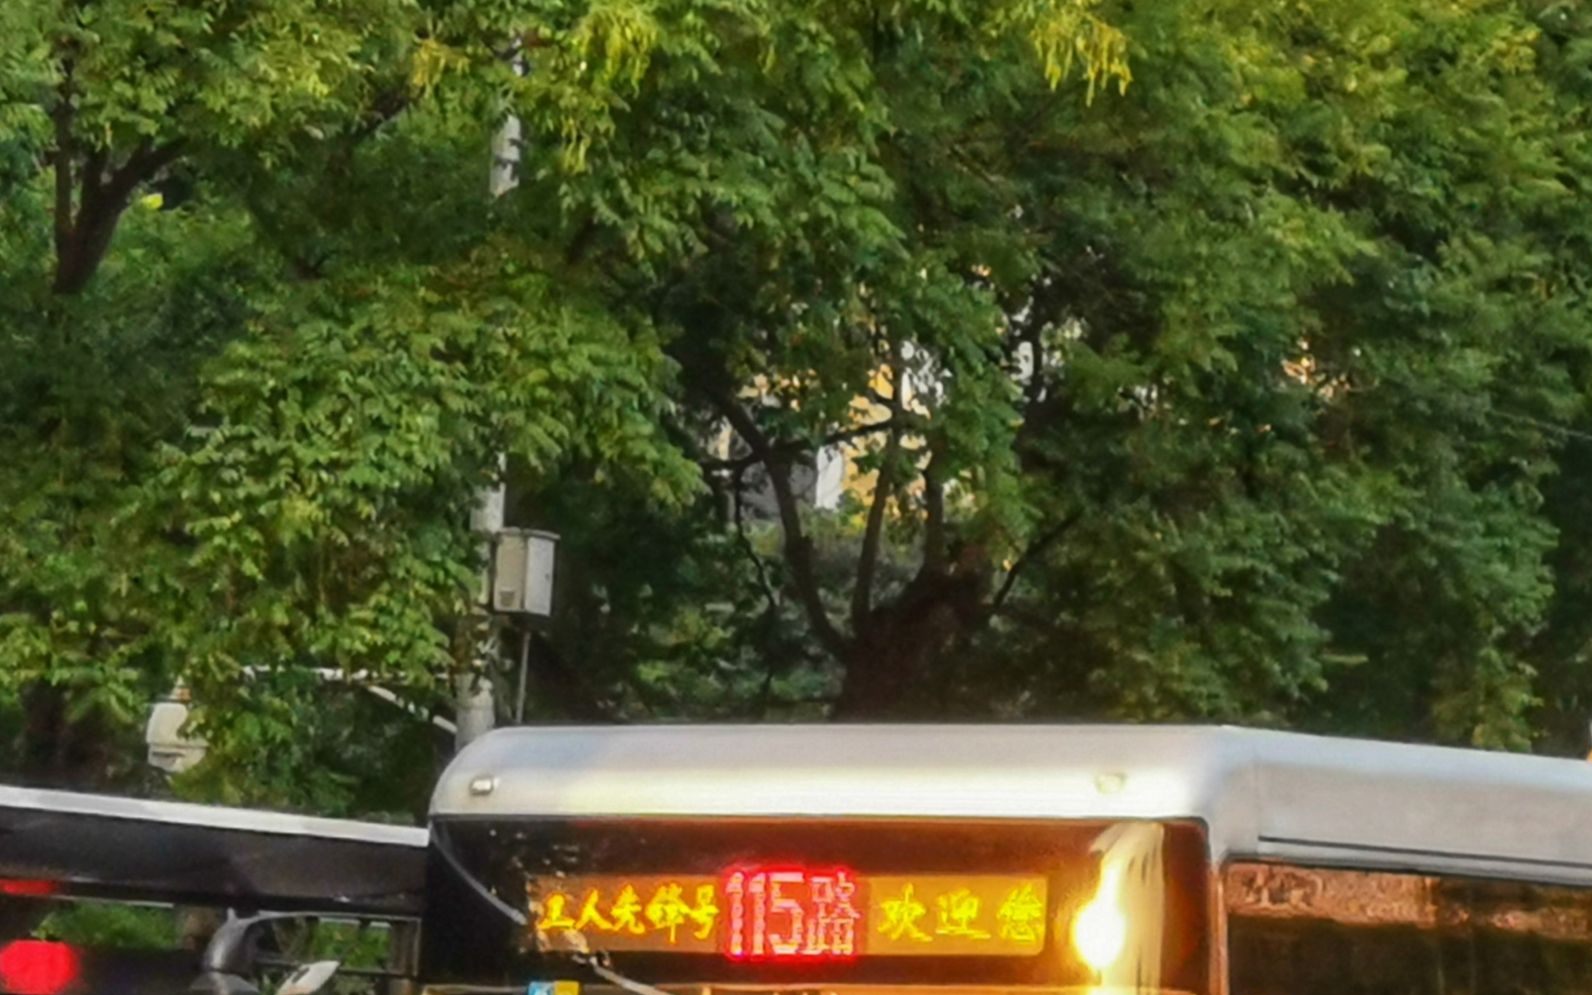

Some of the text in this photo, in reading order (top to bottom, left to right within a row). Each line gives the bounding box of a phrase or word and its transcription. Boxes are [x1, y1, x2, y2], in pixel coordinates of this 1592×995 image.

[725, 871, 860, 956] 115路
[877, 882, 1047, 942] 欢迎您
